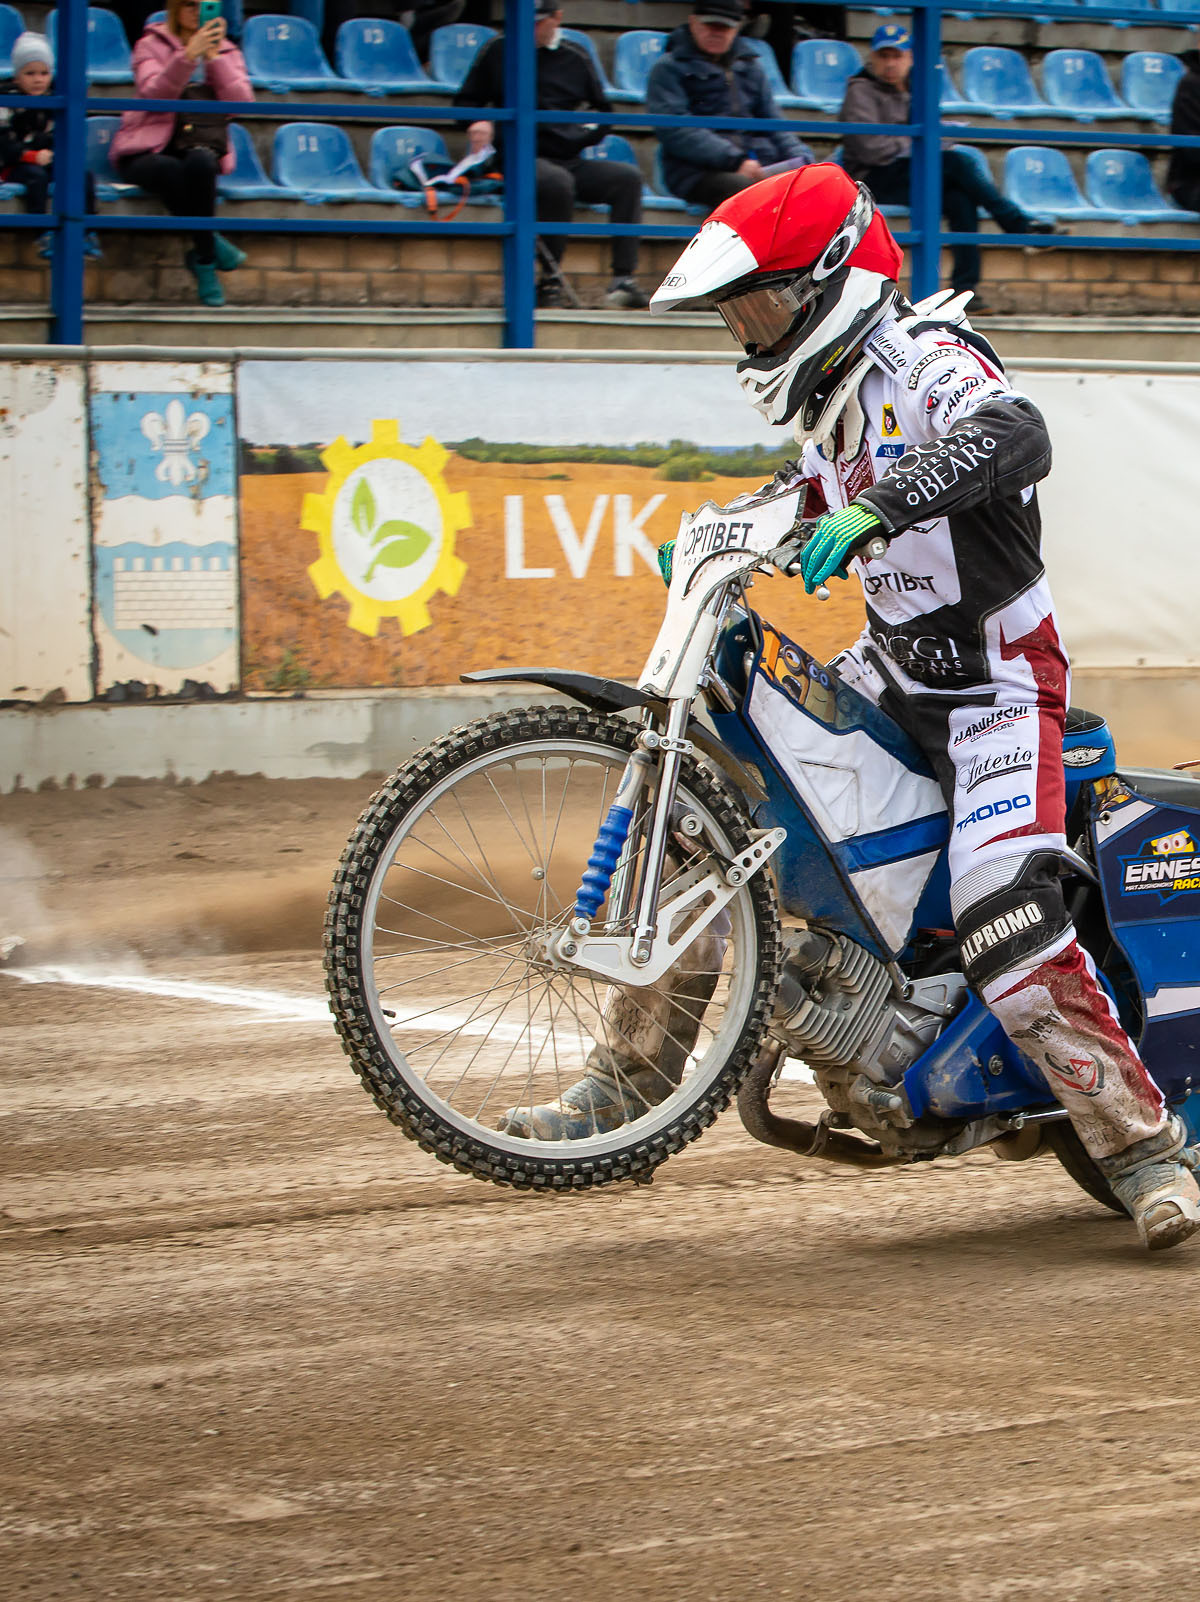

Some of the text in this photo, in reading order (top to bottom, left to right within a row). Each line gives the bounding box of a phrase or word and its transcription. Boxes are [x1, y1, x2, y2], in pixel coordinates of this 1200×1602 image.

[684, 522, 754, 557] OPTIBET
[864, 571, 937, 595] OPTIBET
[957, 746, 1037, 789] Interio
[956, 794, 1032, 834] TRODO
[962, 902, 1043, 967] ALPROMO
